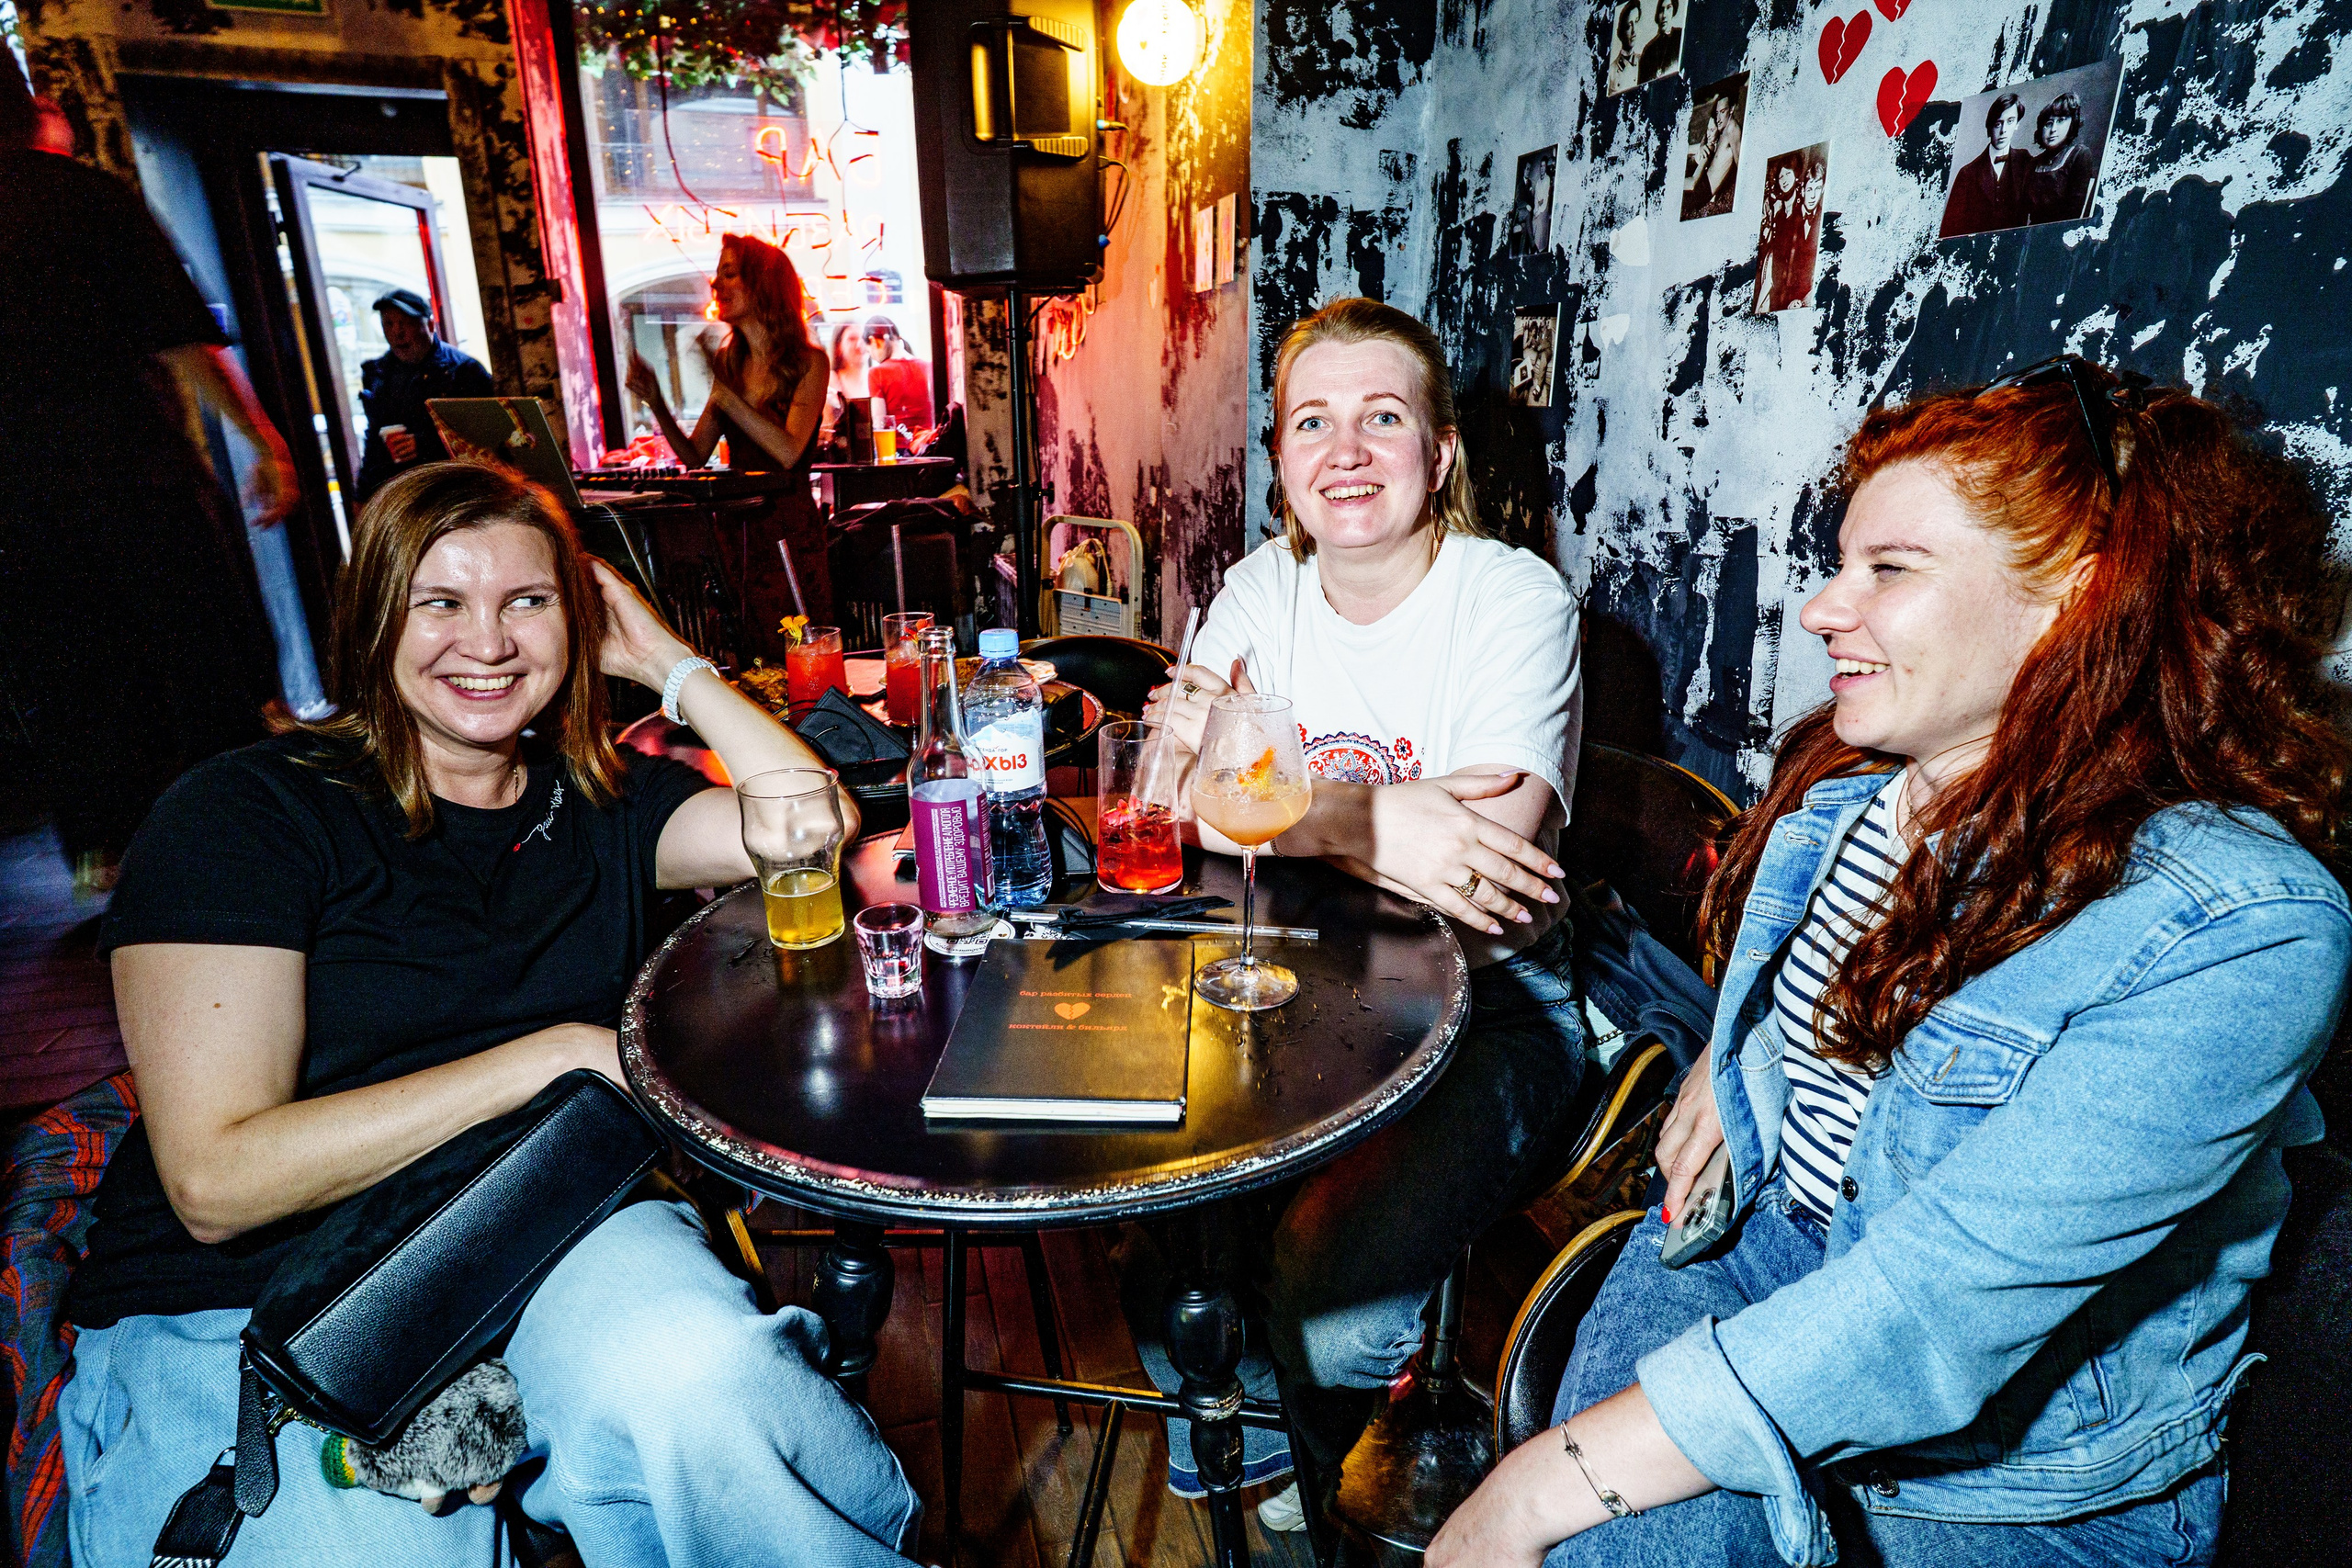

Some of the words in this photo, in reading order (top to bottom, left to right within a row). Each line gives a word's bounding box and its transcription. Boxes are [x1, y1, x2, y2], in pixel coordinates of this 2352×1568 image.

[940, 807, 953, 836] АЛКОГОЛЯ
[951, 807, 966, 846] ЗДОРОВЬЮ
[943, 836, 956, 875] УПОТРЕБЛЕНИЕ
[955, 848, 967, 879] ВАШЕМУ
[946, 875, 959, 908] ЧРЕЗМЕРНОЕ
[958, 880, 970, 908] ВРЕДИТ
